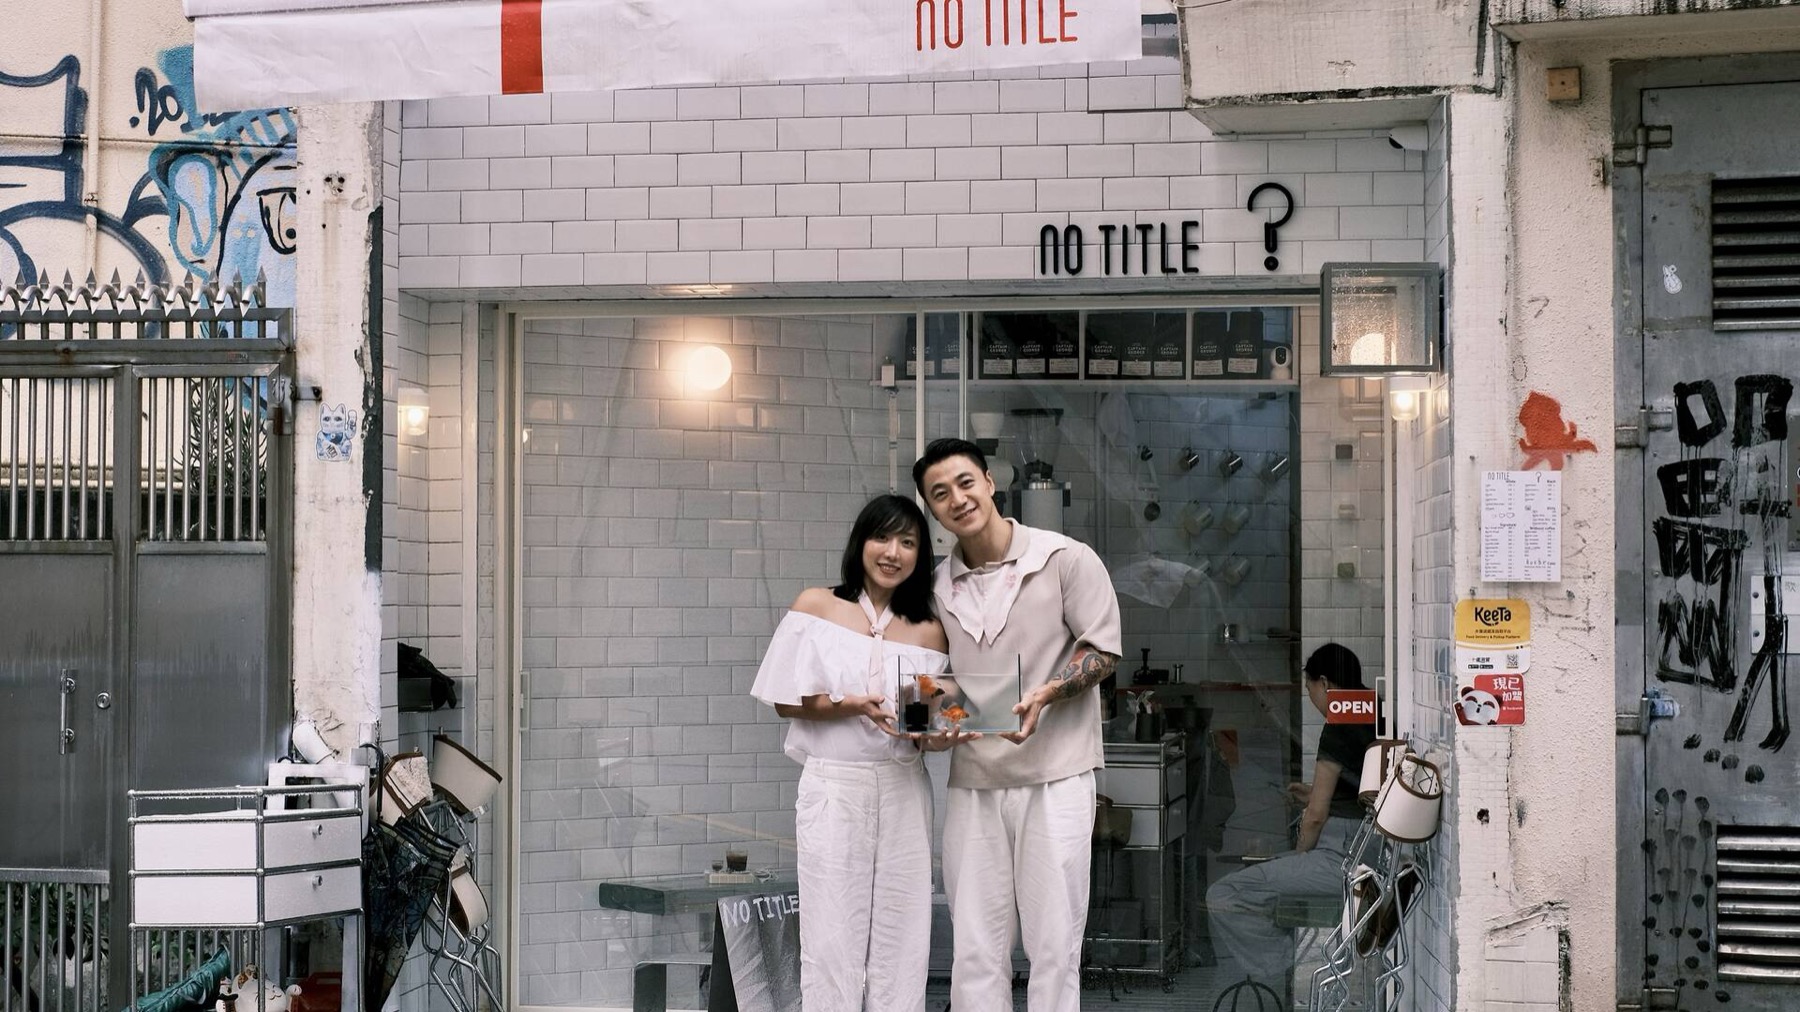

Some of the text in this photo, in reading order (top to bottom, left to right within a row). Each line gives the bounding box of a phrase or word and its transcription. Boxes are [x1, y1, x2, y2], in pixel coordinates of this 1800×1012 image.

[917, 0, 963, 51] NO
[1040, 223, 1083, 276] NO
[1098, 220, 1200, 276] TITLE
[1475, 607, 1511, 626] KeeTa
[1493, 677, 1520, 690] 現已
[1329, 701, 1373, 714] OPEN
[722, 894, 800, 929] NO TITLE
